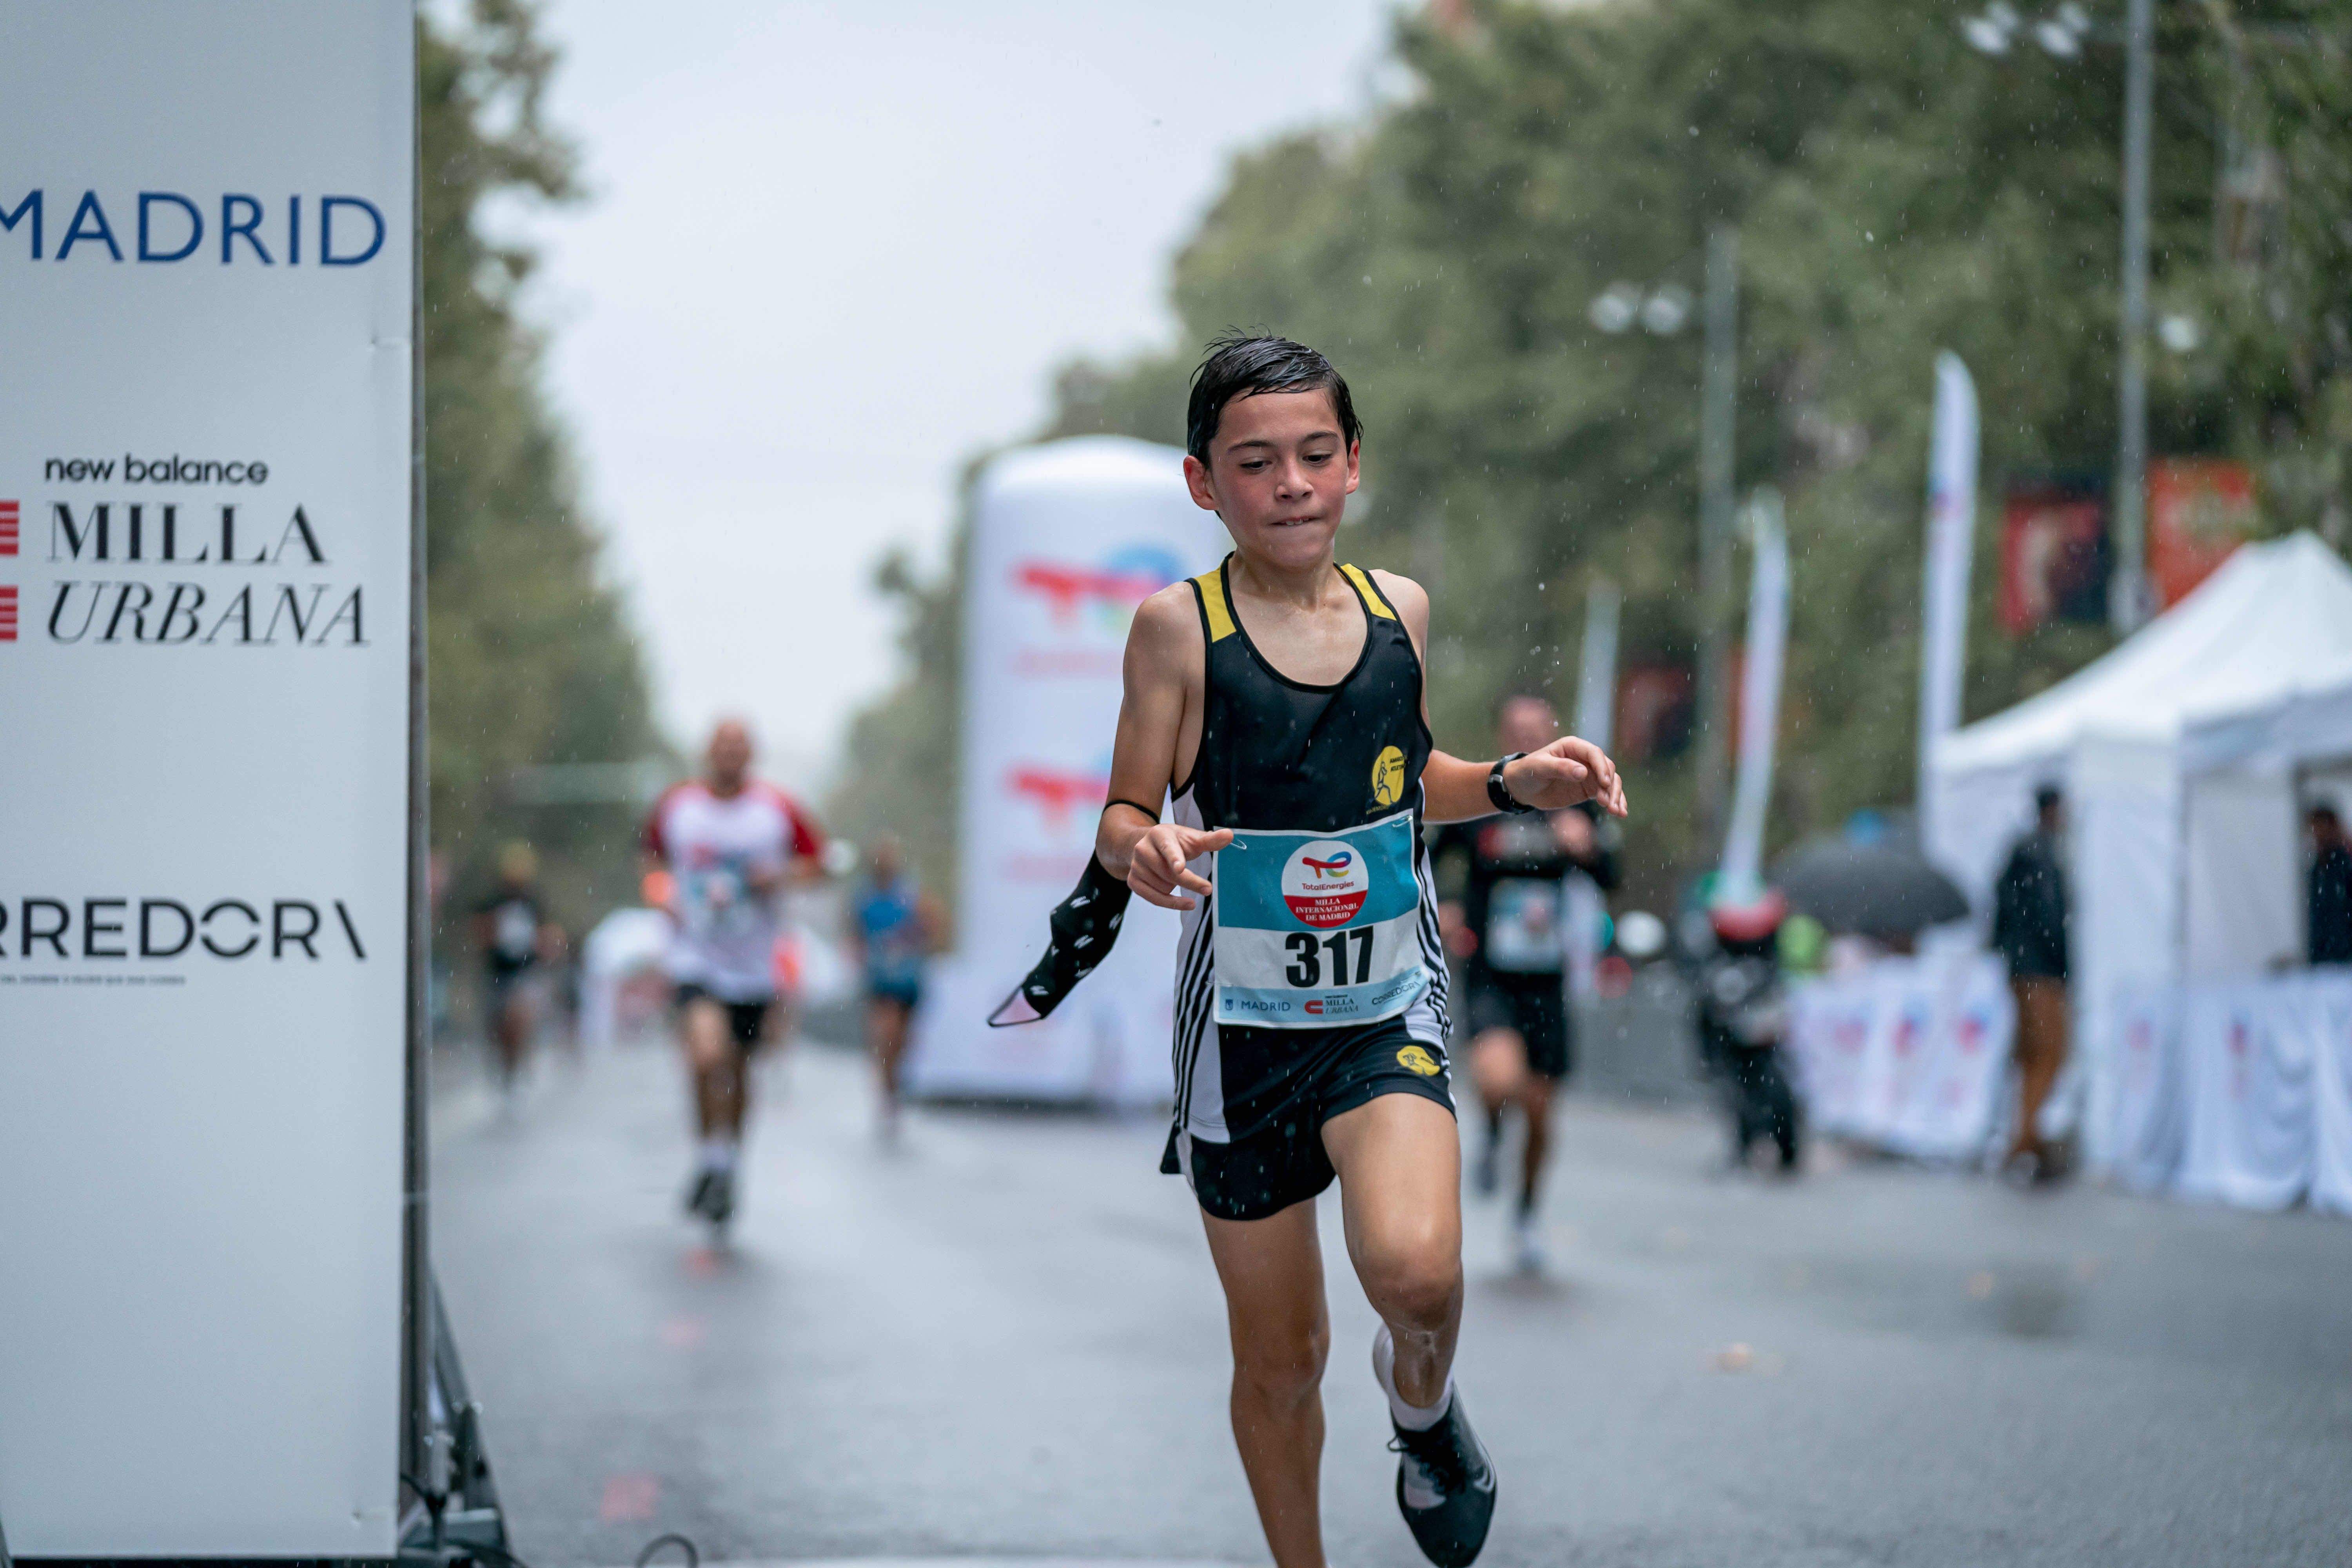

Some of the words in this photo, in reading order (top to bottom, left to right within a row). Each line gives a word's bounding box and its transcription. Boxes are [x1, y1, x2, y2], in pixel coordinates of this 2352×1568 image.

[0, 189, 386, 266] MADRID
[45, 457, 115, 484] new
[123, 453, 270, 485] balance
[46, 501, 331, 566] MILLA
[47, 580, 371, 646] URBANA
[1302, 881, 1354, 891] TotalEnergies
[1315, 897, 1340, 906] MILLA
[1318, 911, 1351, 920] MADRID
[1285, 925, 1374, 988] 317
[1241, 1000, 1291, 1011] MADRID
[1325, 998, 1355, 1006] MILLA
